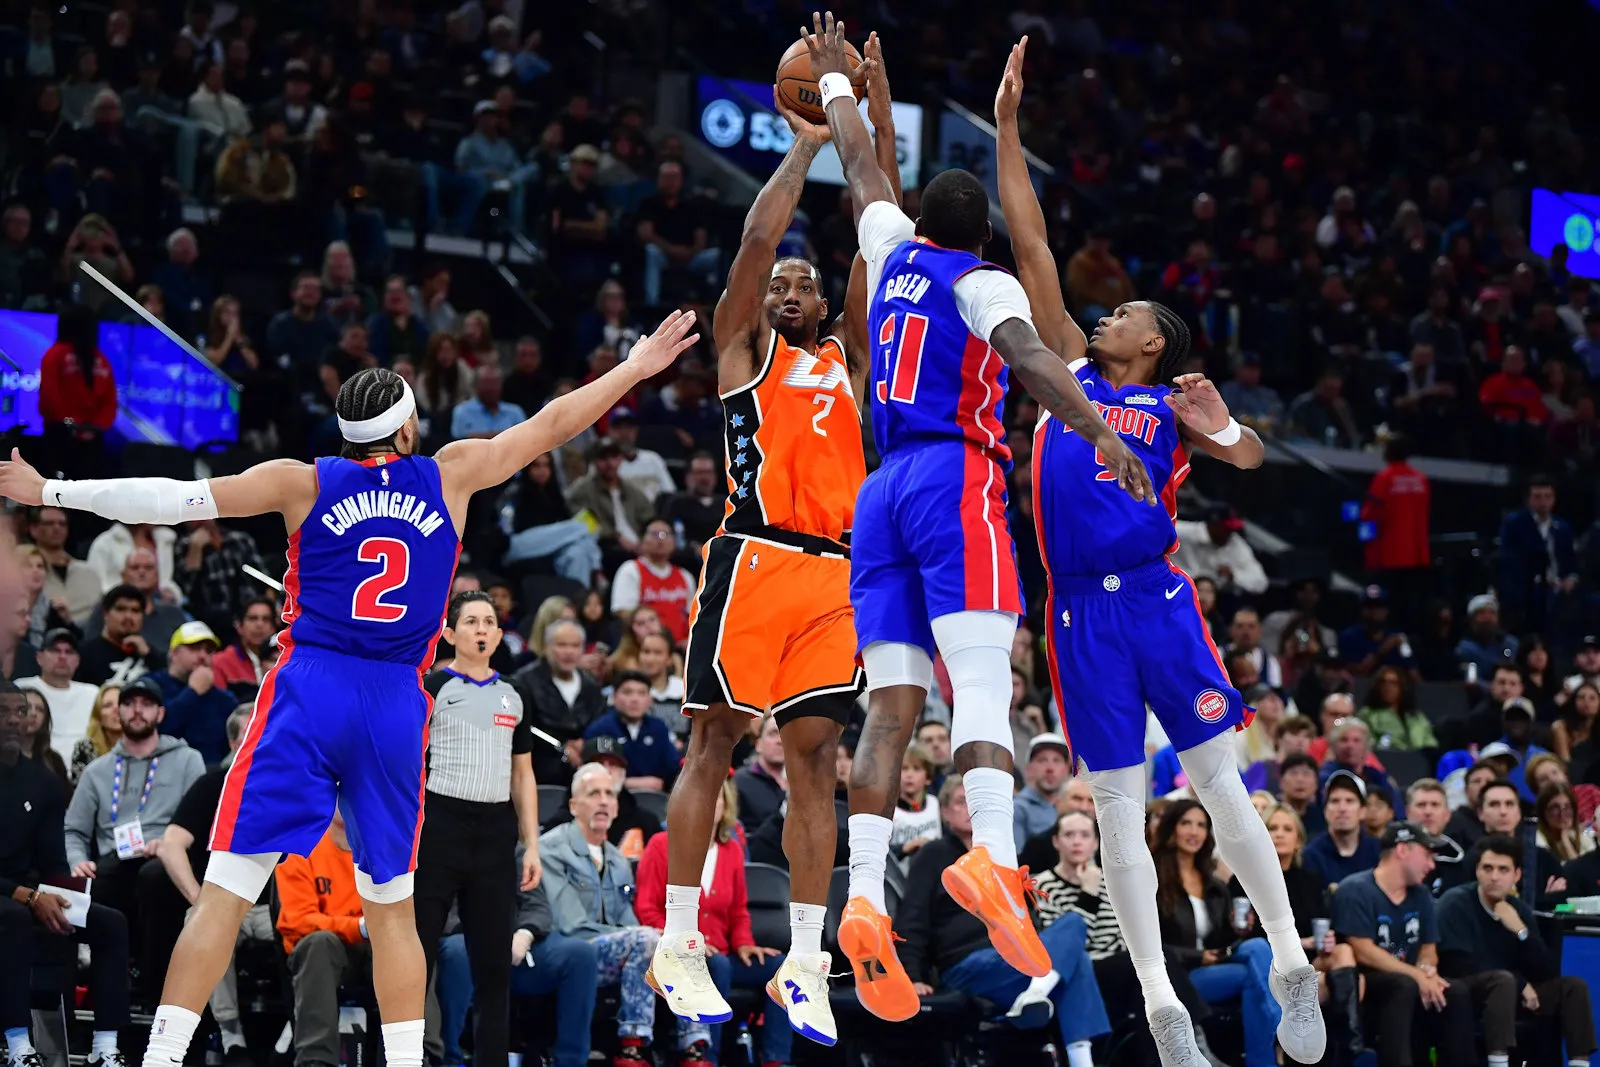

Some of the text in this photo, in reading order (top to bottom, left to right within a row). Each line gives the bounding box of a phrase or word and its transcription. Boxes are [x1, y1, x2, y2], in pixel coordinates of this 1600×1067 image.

[884, 273, 931, 304] GREEN
[812, 393, 836, 437] 2
[1063, 400, 1161, 446] TROIT
[321, 490, 444, 537] CUNNINGHAM
[352, 537, 410, 623] 2
